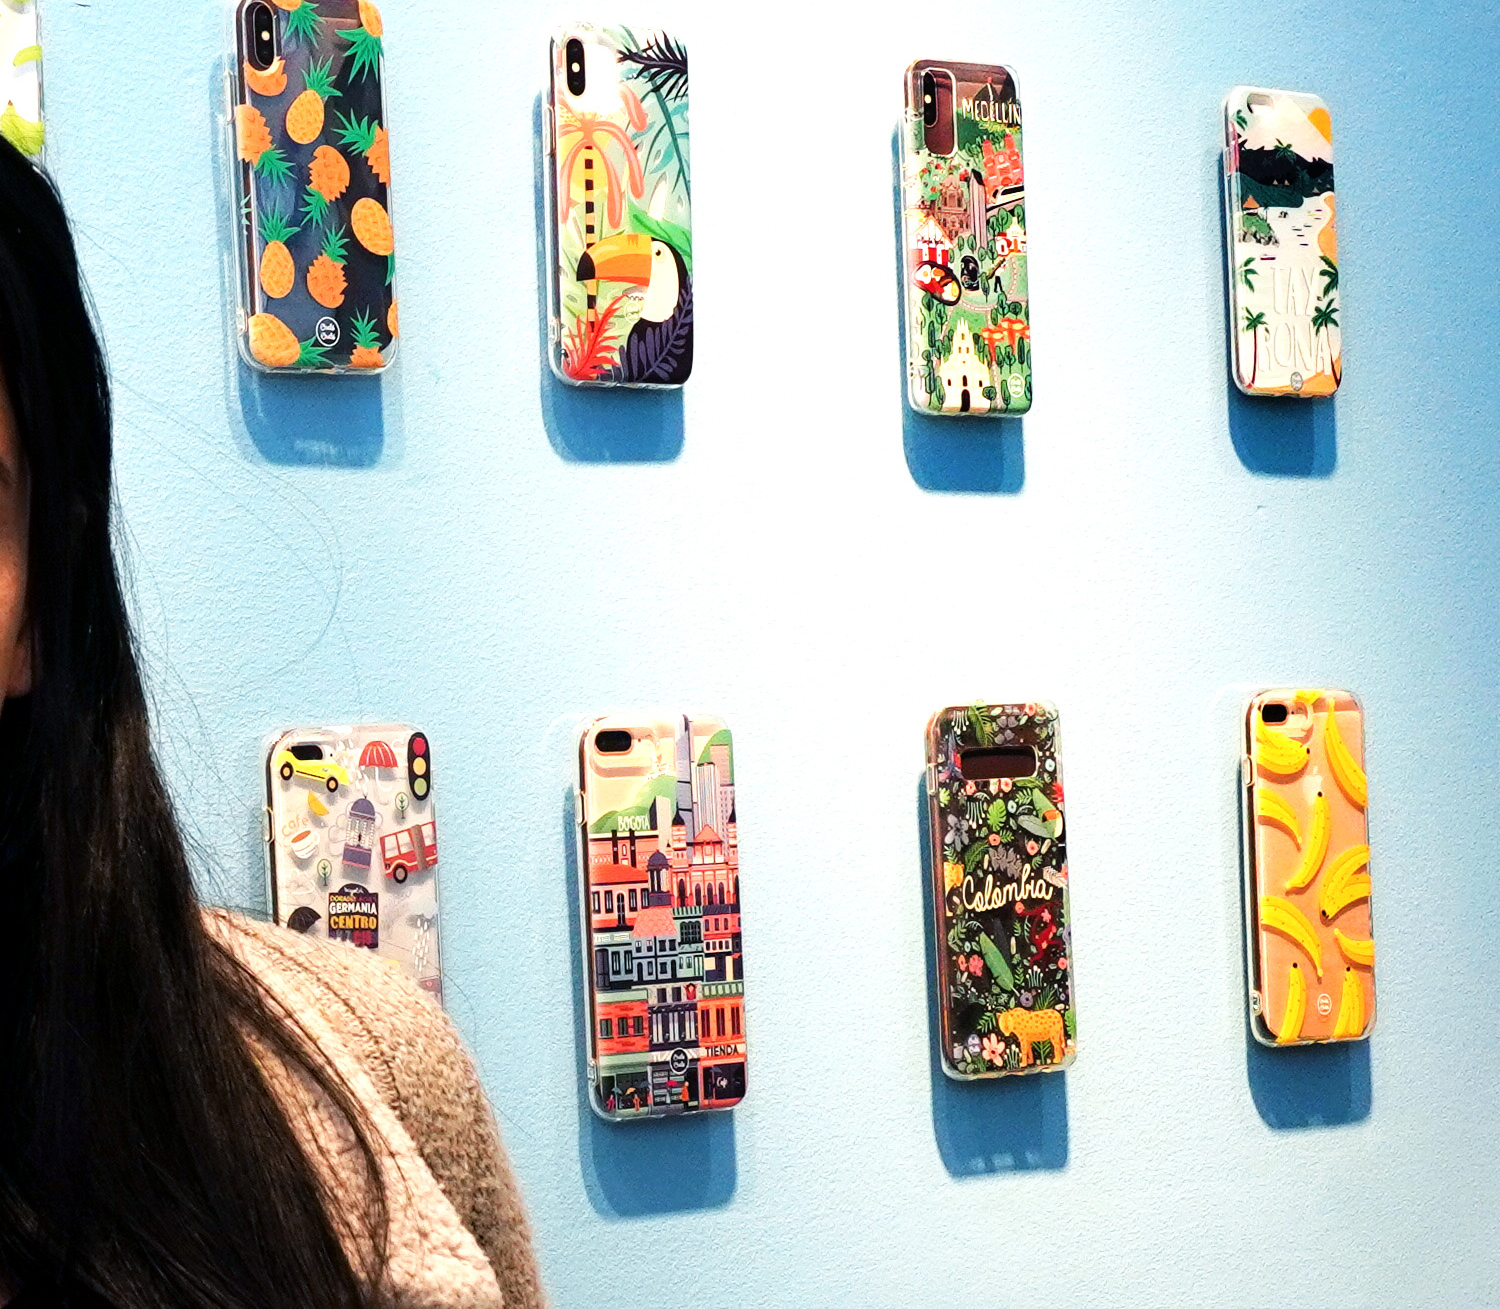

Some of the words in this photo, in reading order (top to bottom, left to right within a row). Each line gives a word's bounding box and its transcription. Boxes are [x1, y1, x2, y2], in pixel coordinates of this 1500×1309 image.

[962, 862, 1054, 912] Colombia
[329, 902, 378, 915] GERMANIA
[330, 914, 378, 930] CENTRO
[705, 1044, 740, 1058] TIENDA
